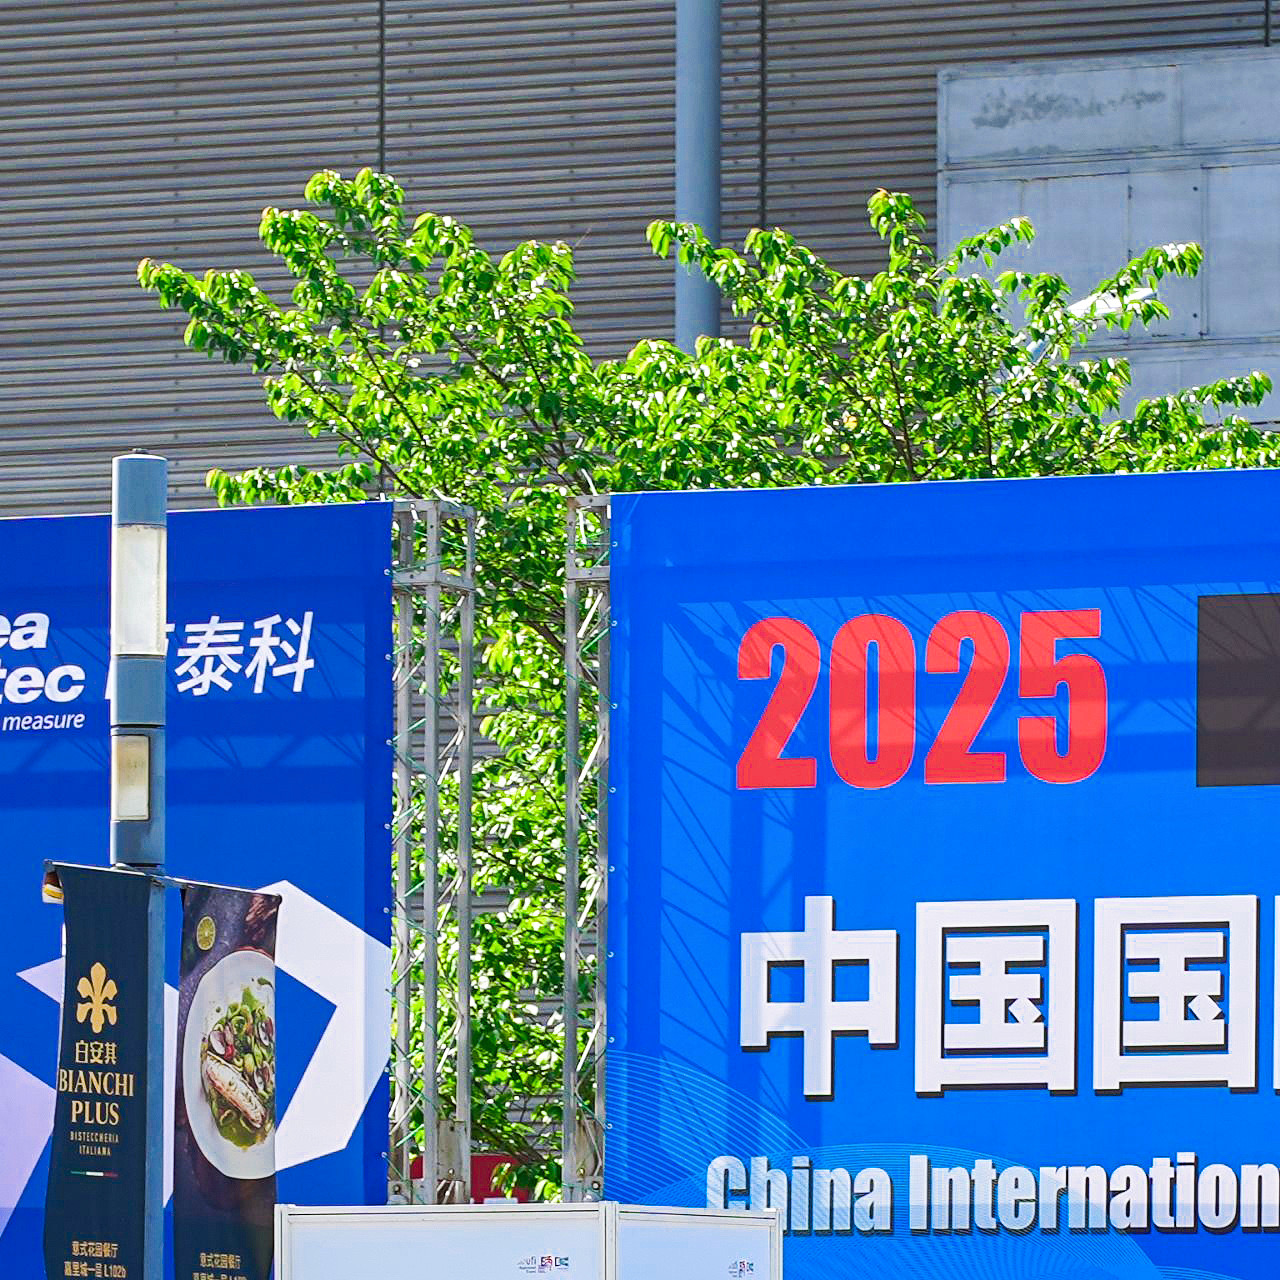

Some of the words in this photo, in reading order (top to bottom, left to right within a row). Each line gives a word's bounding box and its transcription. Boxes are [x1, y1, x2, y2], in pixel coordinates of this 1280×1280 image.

[105, 611, 315, 700] 泰科
[1, 711, 86, 732] measure
[735, 608, 1109, 791] 2025
[59, 1068, 135, 1098] BIANCHI
[71, 1099, 120, 1126] PLUS
[707, 1155, 894, 1235] China
